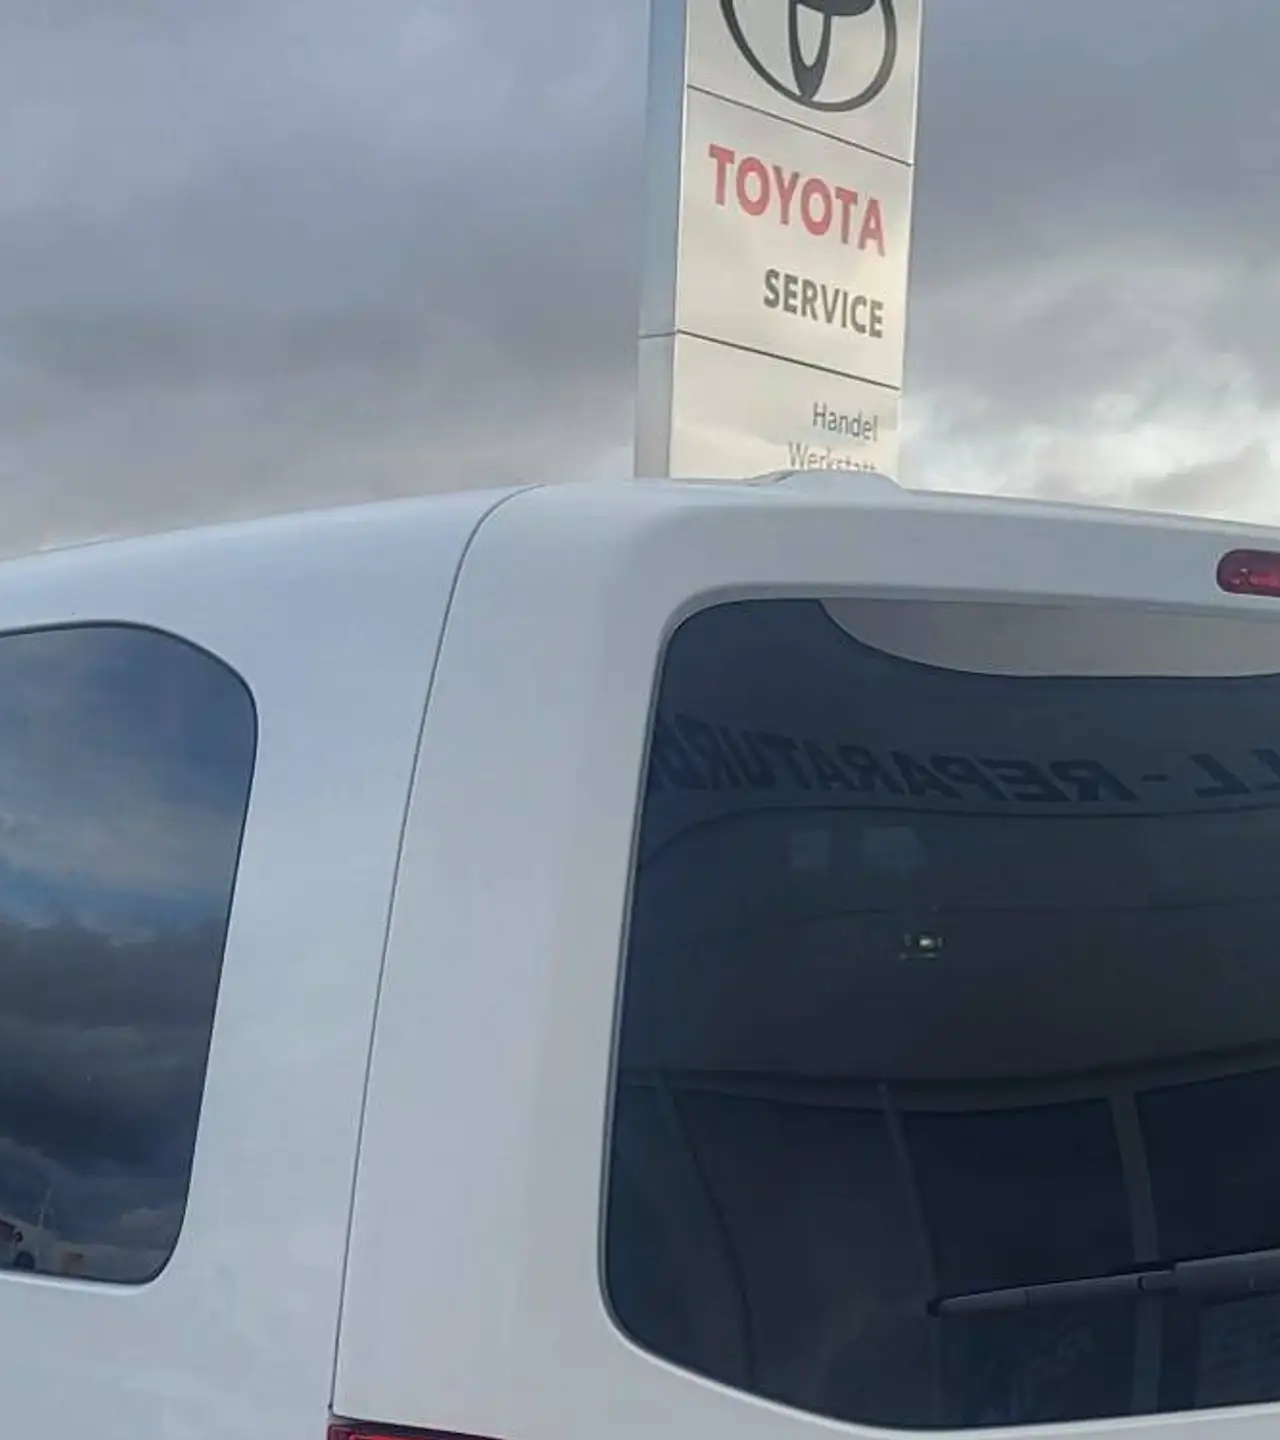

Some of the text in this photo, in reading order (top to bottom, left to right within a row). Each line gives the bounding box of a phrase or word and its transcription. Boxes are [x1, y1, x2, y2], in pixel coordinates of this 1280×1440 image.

[708, 143, 886, 257] TOYOTA
[763, 268, 884, 339] SERVICE
[812, 401, 878, 442] Handel
